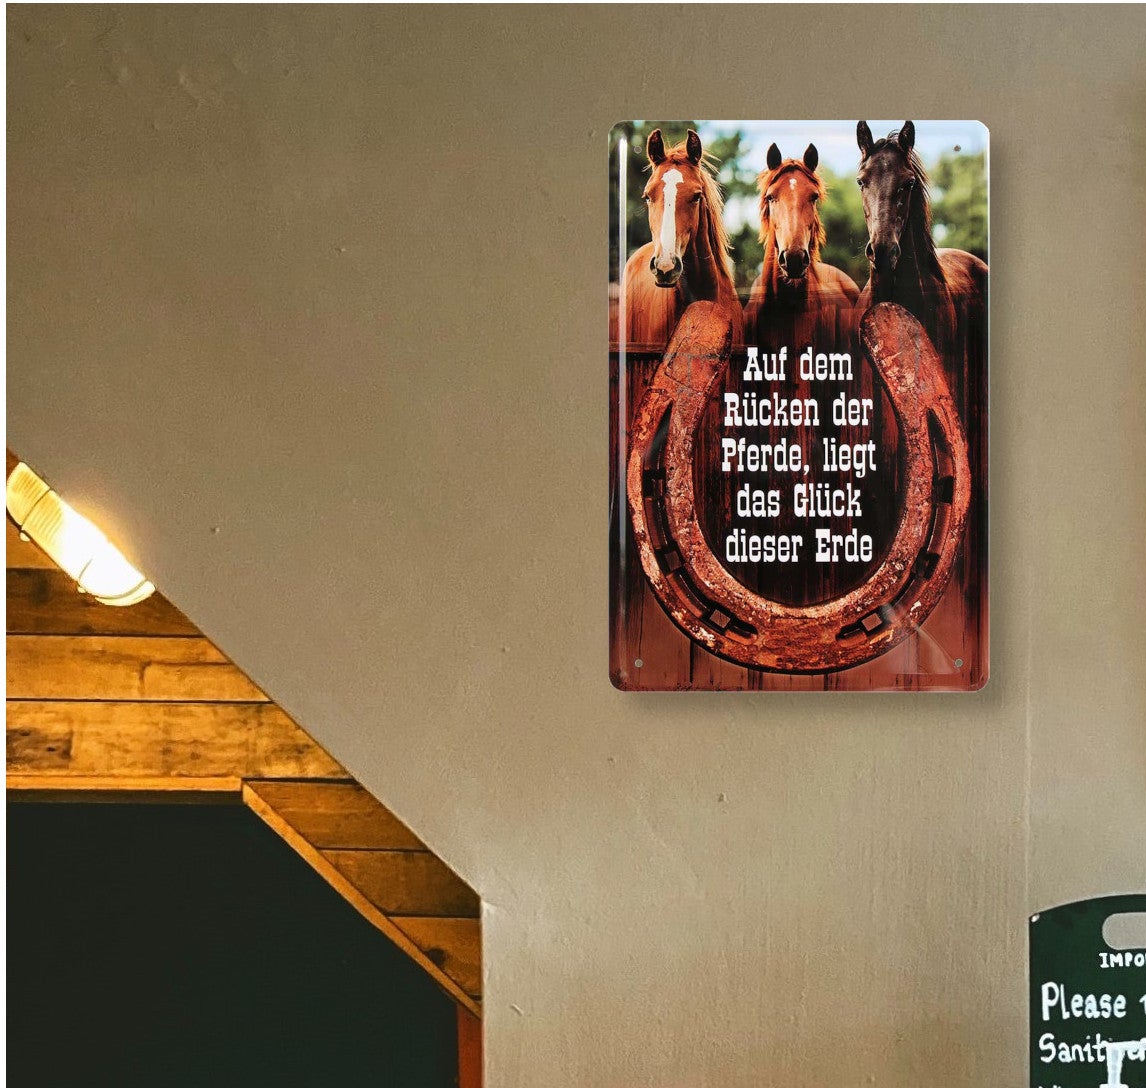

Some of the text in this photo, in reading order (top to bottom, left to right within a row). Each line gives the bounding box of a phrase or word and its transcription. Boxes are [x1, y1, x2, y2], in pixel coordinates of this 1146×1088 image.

[744, 347, 853, 381] Auf dem
[724, 392, 873, 427] Rücken der
[722, 438, 877, 478] Pferde, liegt
[737, 483, 862, 518] das Glück
[726, 529, 873, 563] dieser Erde
[1041, 982, 1127, 1021] Please
